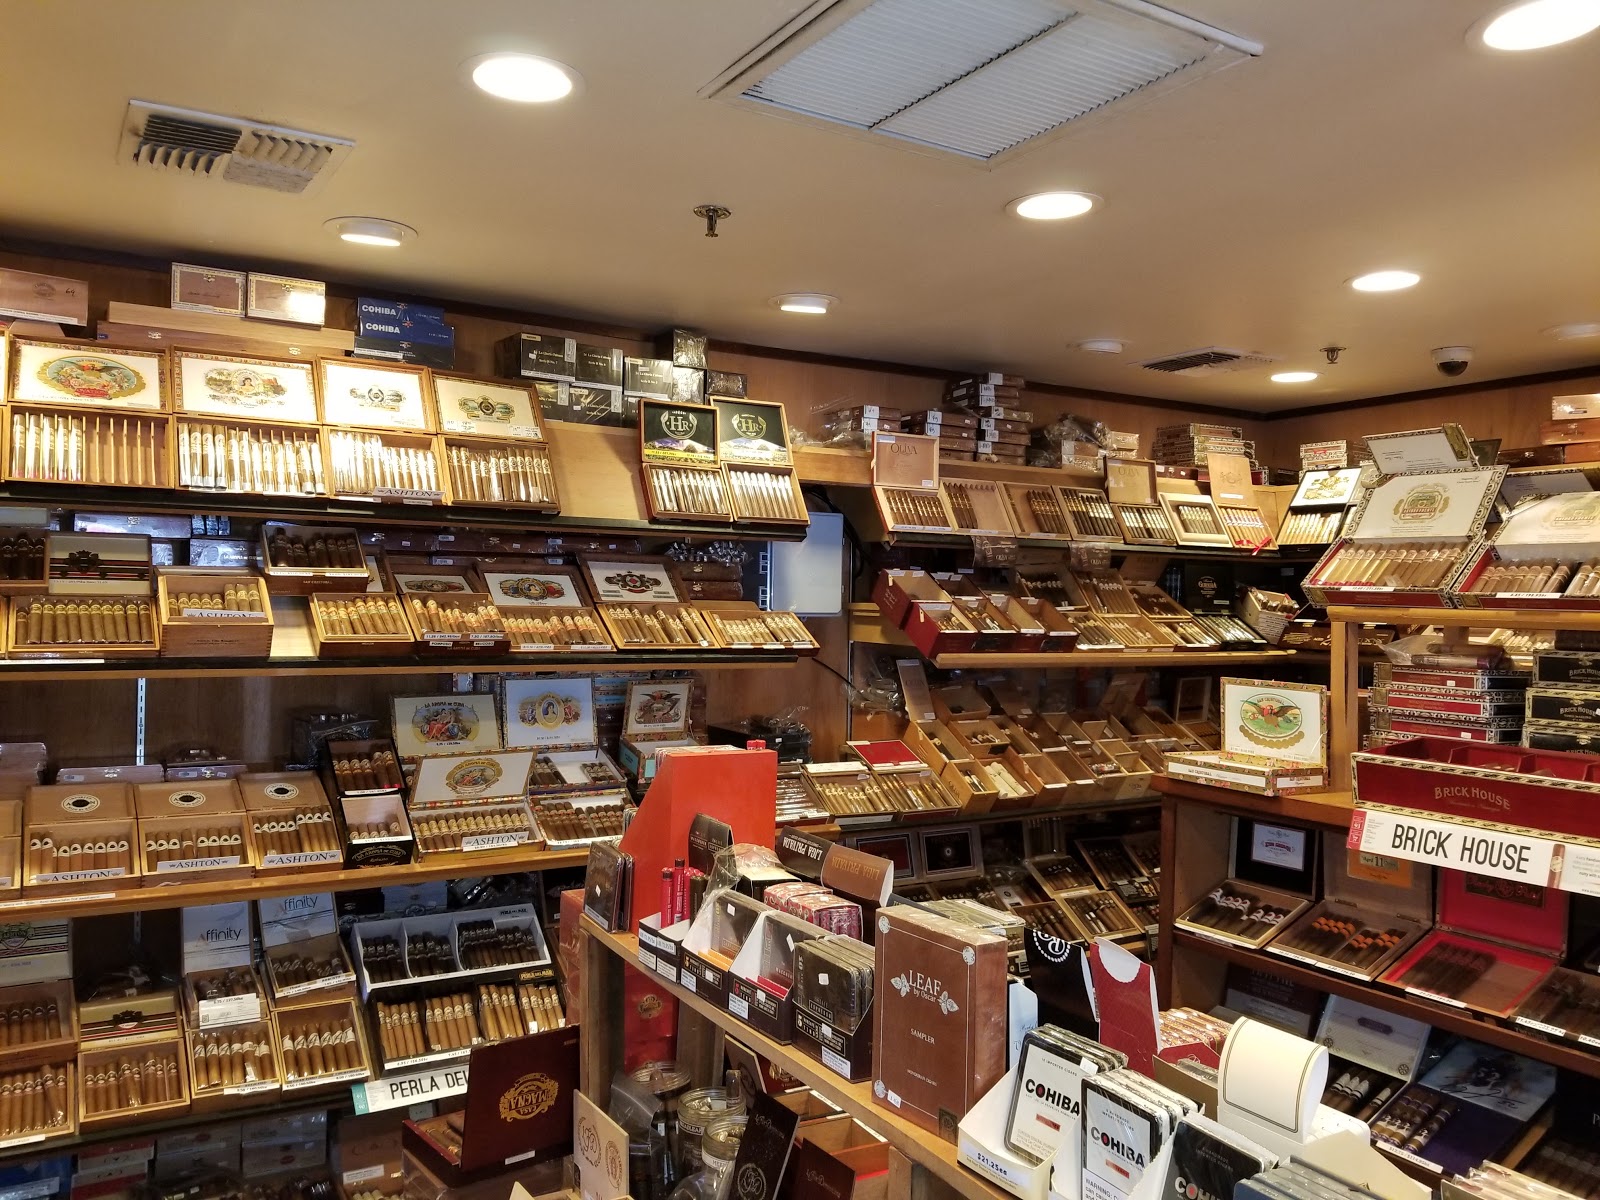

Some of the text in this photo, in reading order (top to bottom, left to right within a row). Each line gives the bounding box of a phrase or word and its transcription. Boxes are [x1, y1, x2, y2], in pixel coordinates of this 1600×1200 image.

[362, 304, 397, 316] COHIBA
[365, 322, 400, 334] COHIBA
[669, 415, 690, 431] HR
[740, 418, 760, 432] HR
[891, 442, 918, 455] OLIVA
[384, 488, 434, 497] ASHTON
[197, 610, 252, 618] ASHTON
[1434, 786, 1511, 810] BRICK HOUSE
[471, 834, 518, 846] ASHTON
[783, 836, 806, 856] PRIVADA
[806, 845, 824, 861] LIGA
[1391, 823, 1531, 874] BRICK HOUSE
[175, 859, 222, 869] ASHTON
[275, 852, 329, 865] ASHTON
[1375, 856, 1384, 868] 11
[51, 870, 112, 882] ASHTON
[831, 857, 881, 881] LIGA PRIVADA
[909, 970, 942, 996] LEAF
[913, 987, 937, 1003] by Oscar
[910, 1028, 935, 1045] SAMPLER
[389, 1076, 440, 1100] PERLA
[509, 1088, 551, 1110] MAGNA
[1025, 1078, 1080, 1117] COHIBA
[1090, 1126, 1145, 1168] COHIBA
[1085, 1178, 1113, 1197] WARNING:
[1085, 1186, 1095, 1196] can
